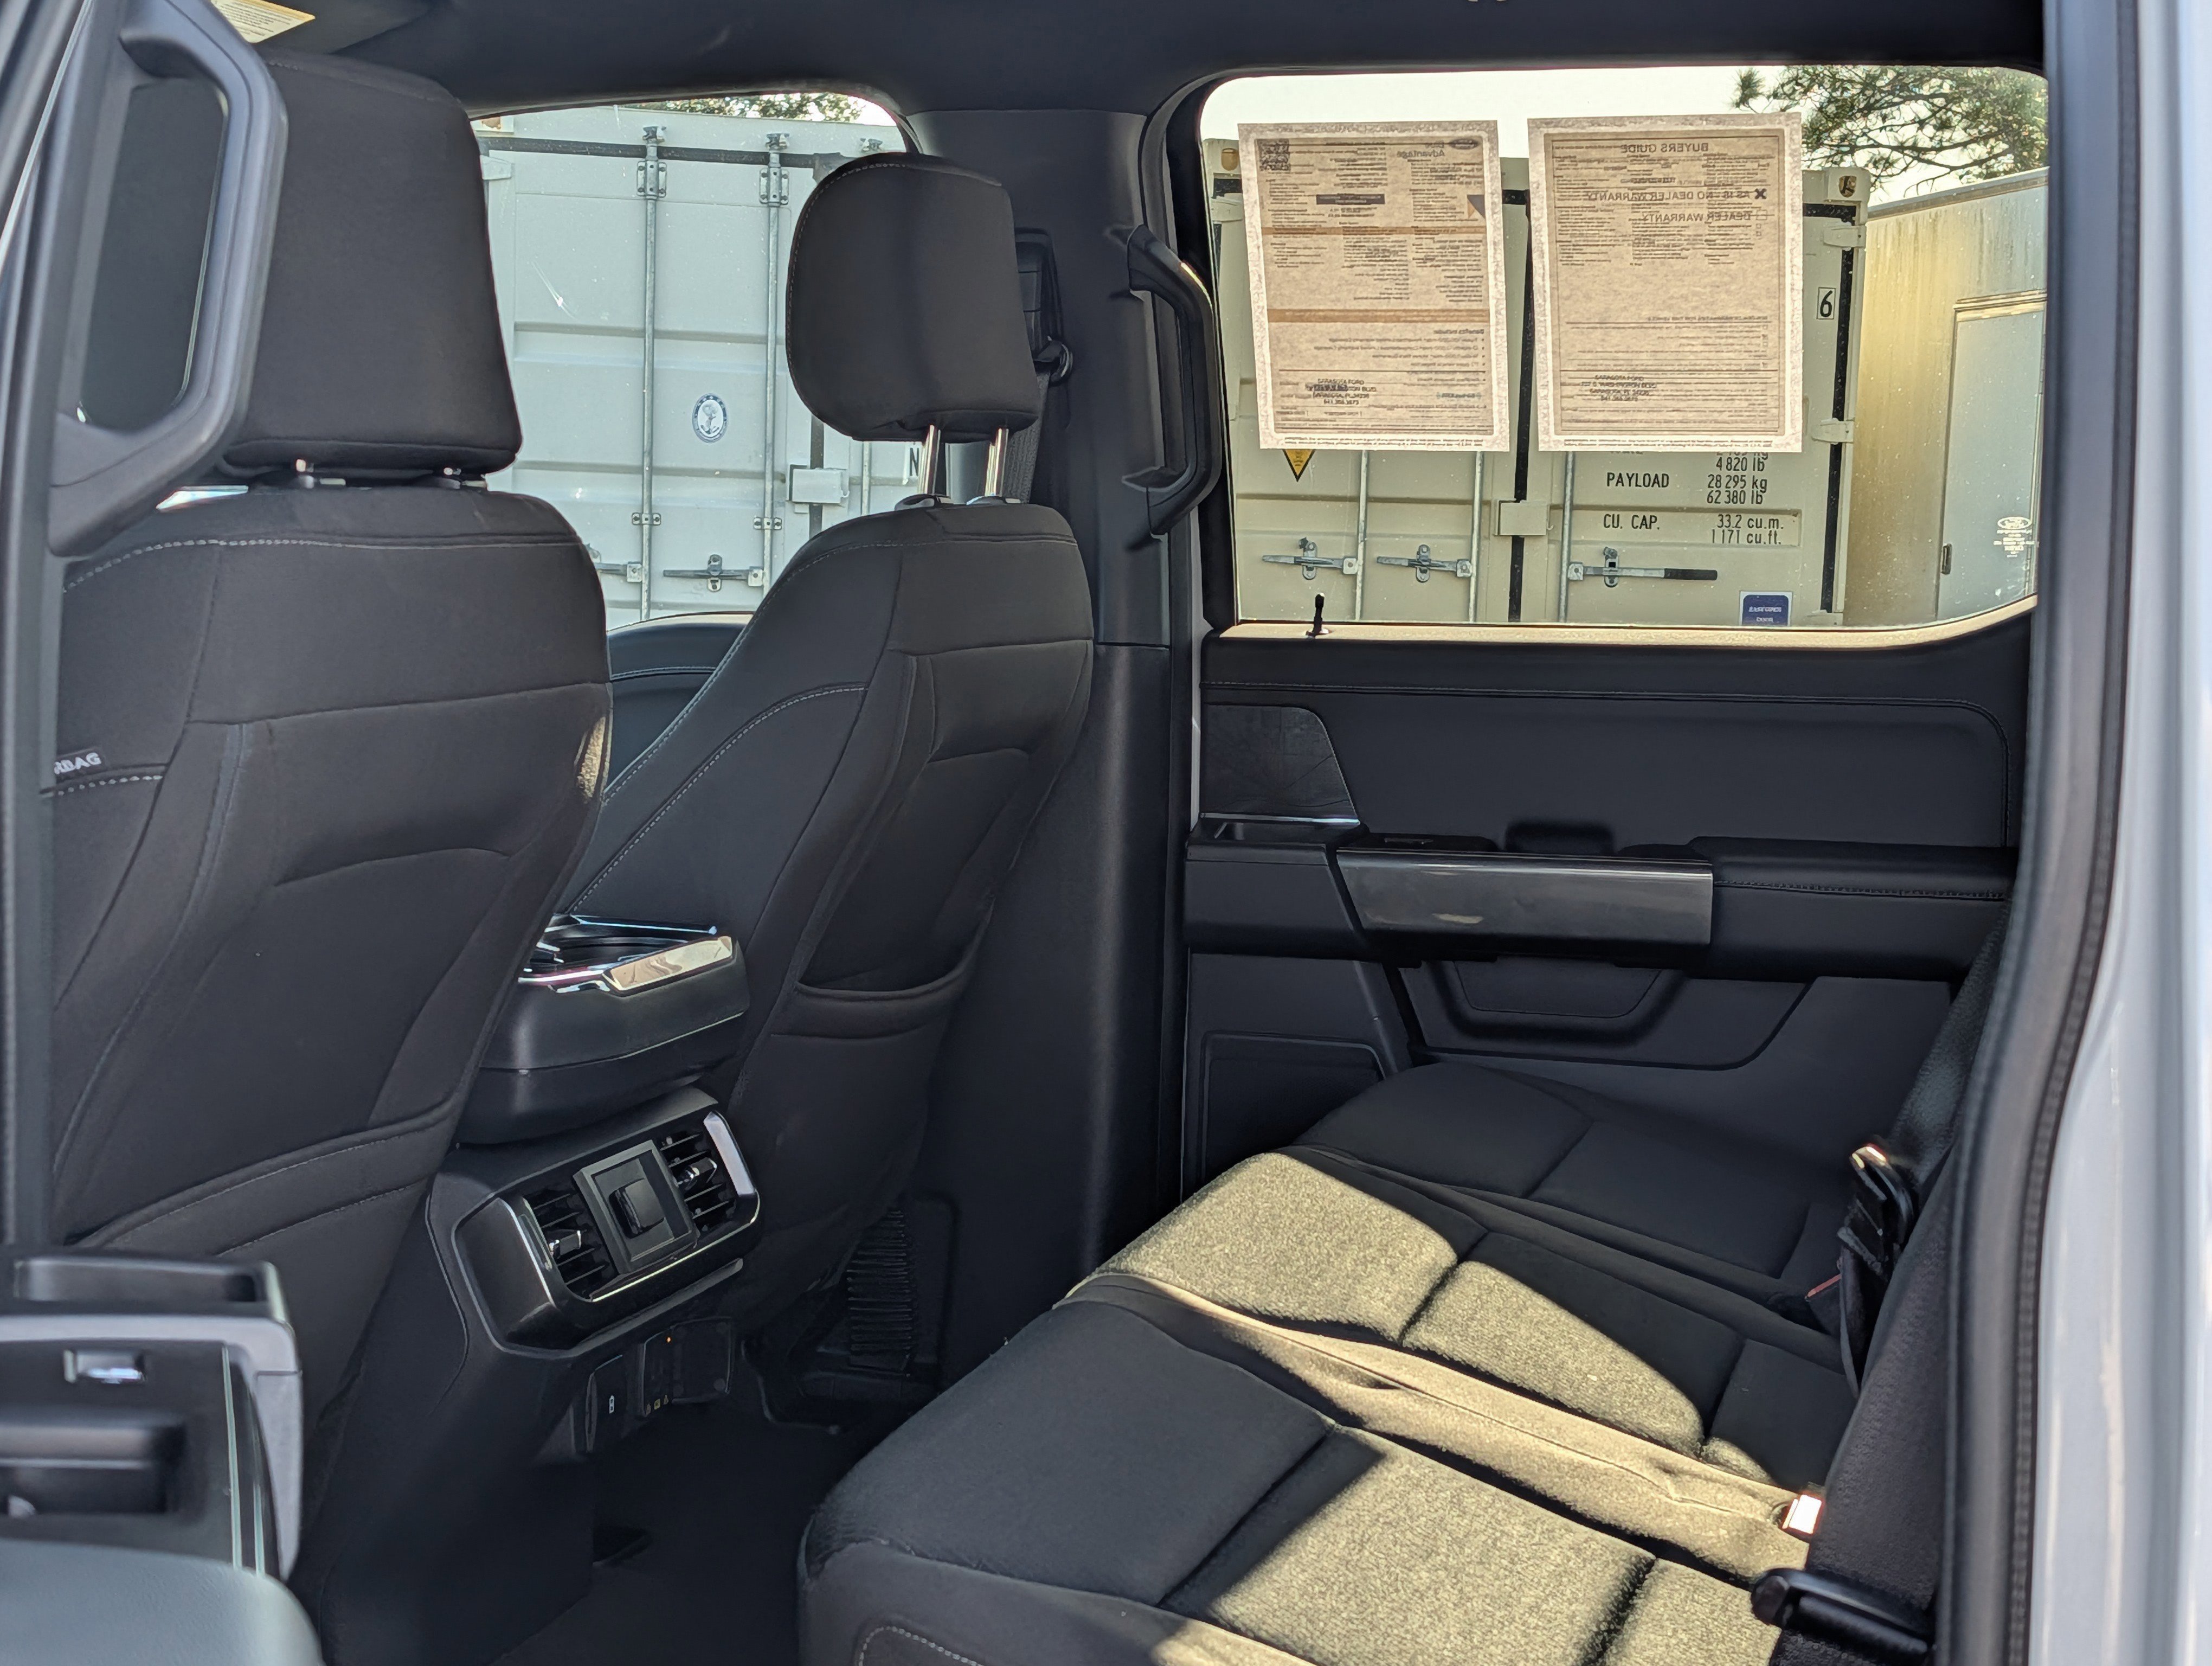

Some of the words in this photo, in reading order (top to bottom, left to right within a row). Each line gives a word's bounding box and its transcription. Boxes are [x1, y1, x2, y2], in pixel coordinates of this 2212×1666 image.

[1820, 290, 1833, 317] 6
[1753, 457, 1765, 471] lb
[1606, 472, 1670, 488] PAYLOAD
[1752, 475, 1767, 494] kg
[1751, 490, 1763, 504] lb
[1603, 514, 1623, 529] CU.
[1631, 515, 1660, 530] CAP.
